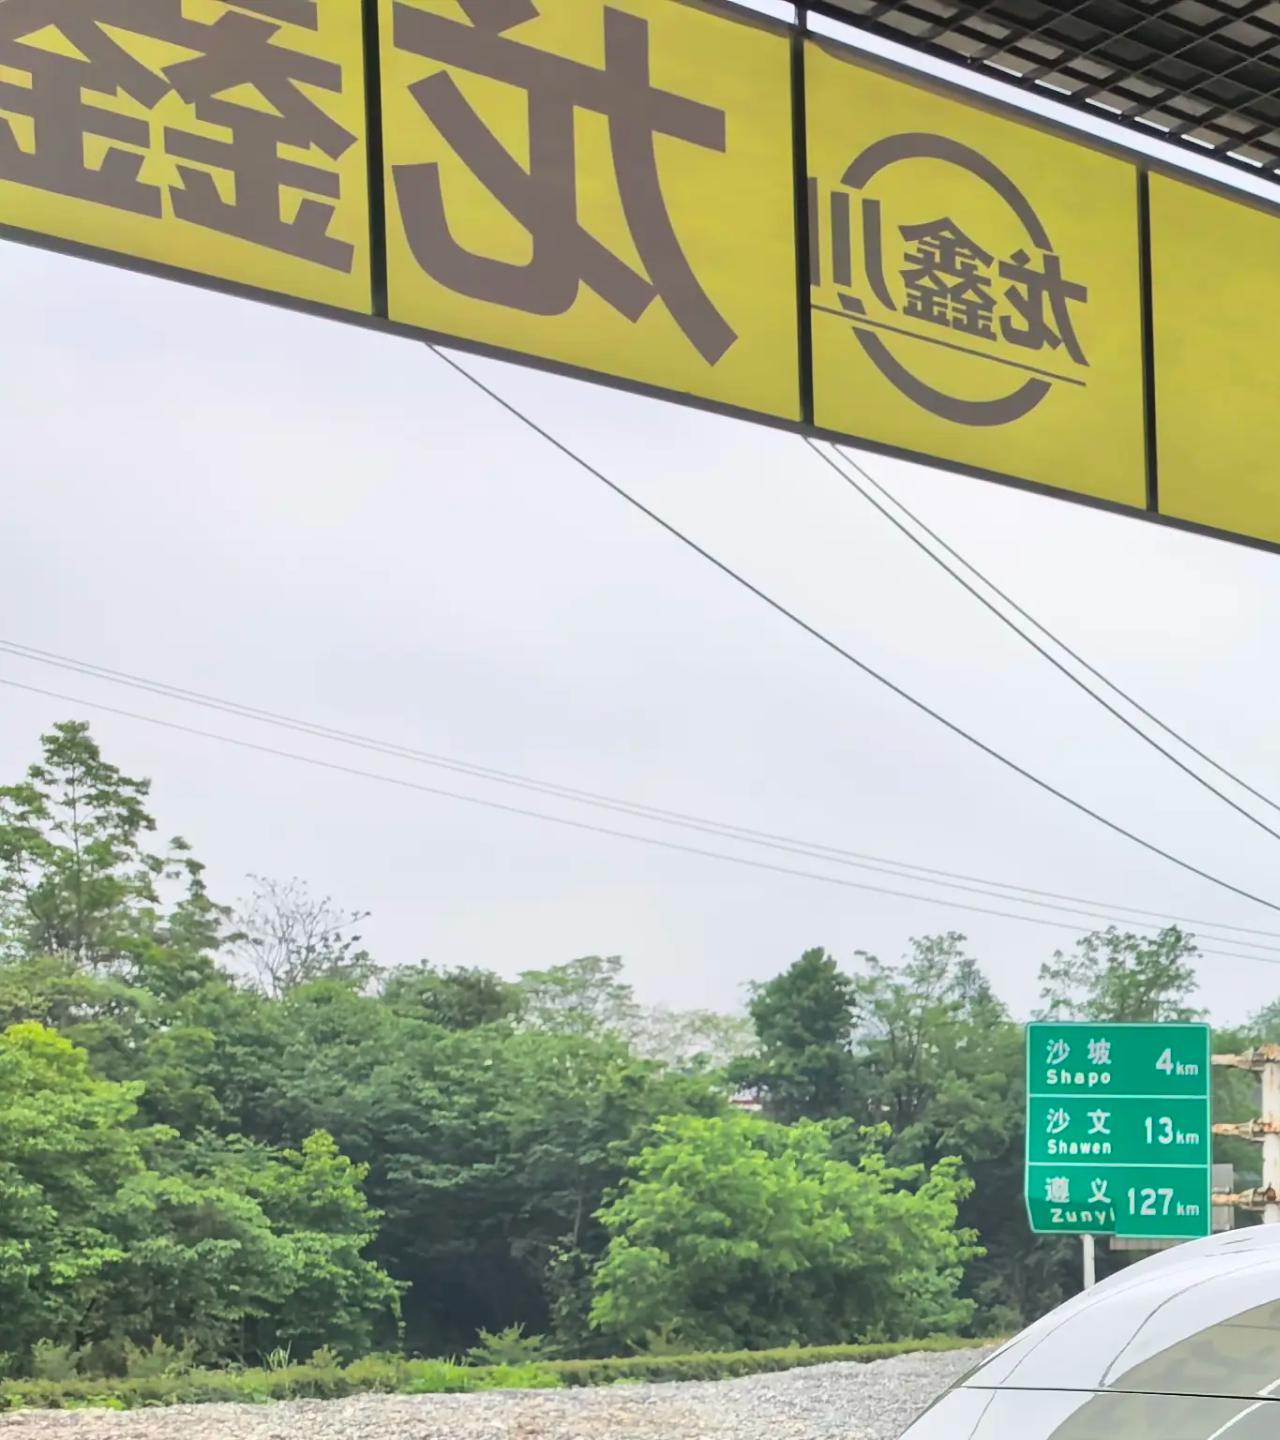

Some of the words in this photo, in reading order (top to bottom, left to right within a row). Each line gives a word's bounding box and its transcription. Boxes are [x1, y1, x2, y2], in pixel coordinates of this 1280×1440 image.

[1046, 1038, 1111, 1065] 沙坡
[1046, 1069, 1111, 1087] Shapo
[1046, 1108, 1111, 1134] 沙文
[1047, 1139, 1111, 1154] Shawen
